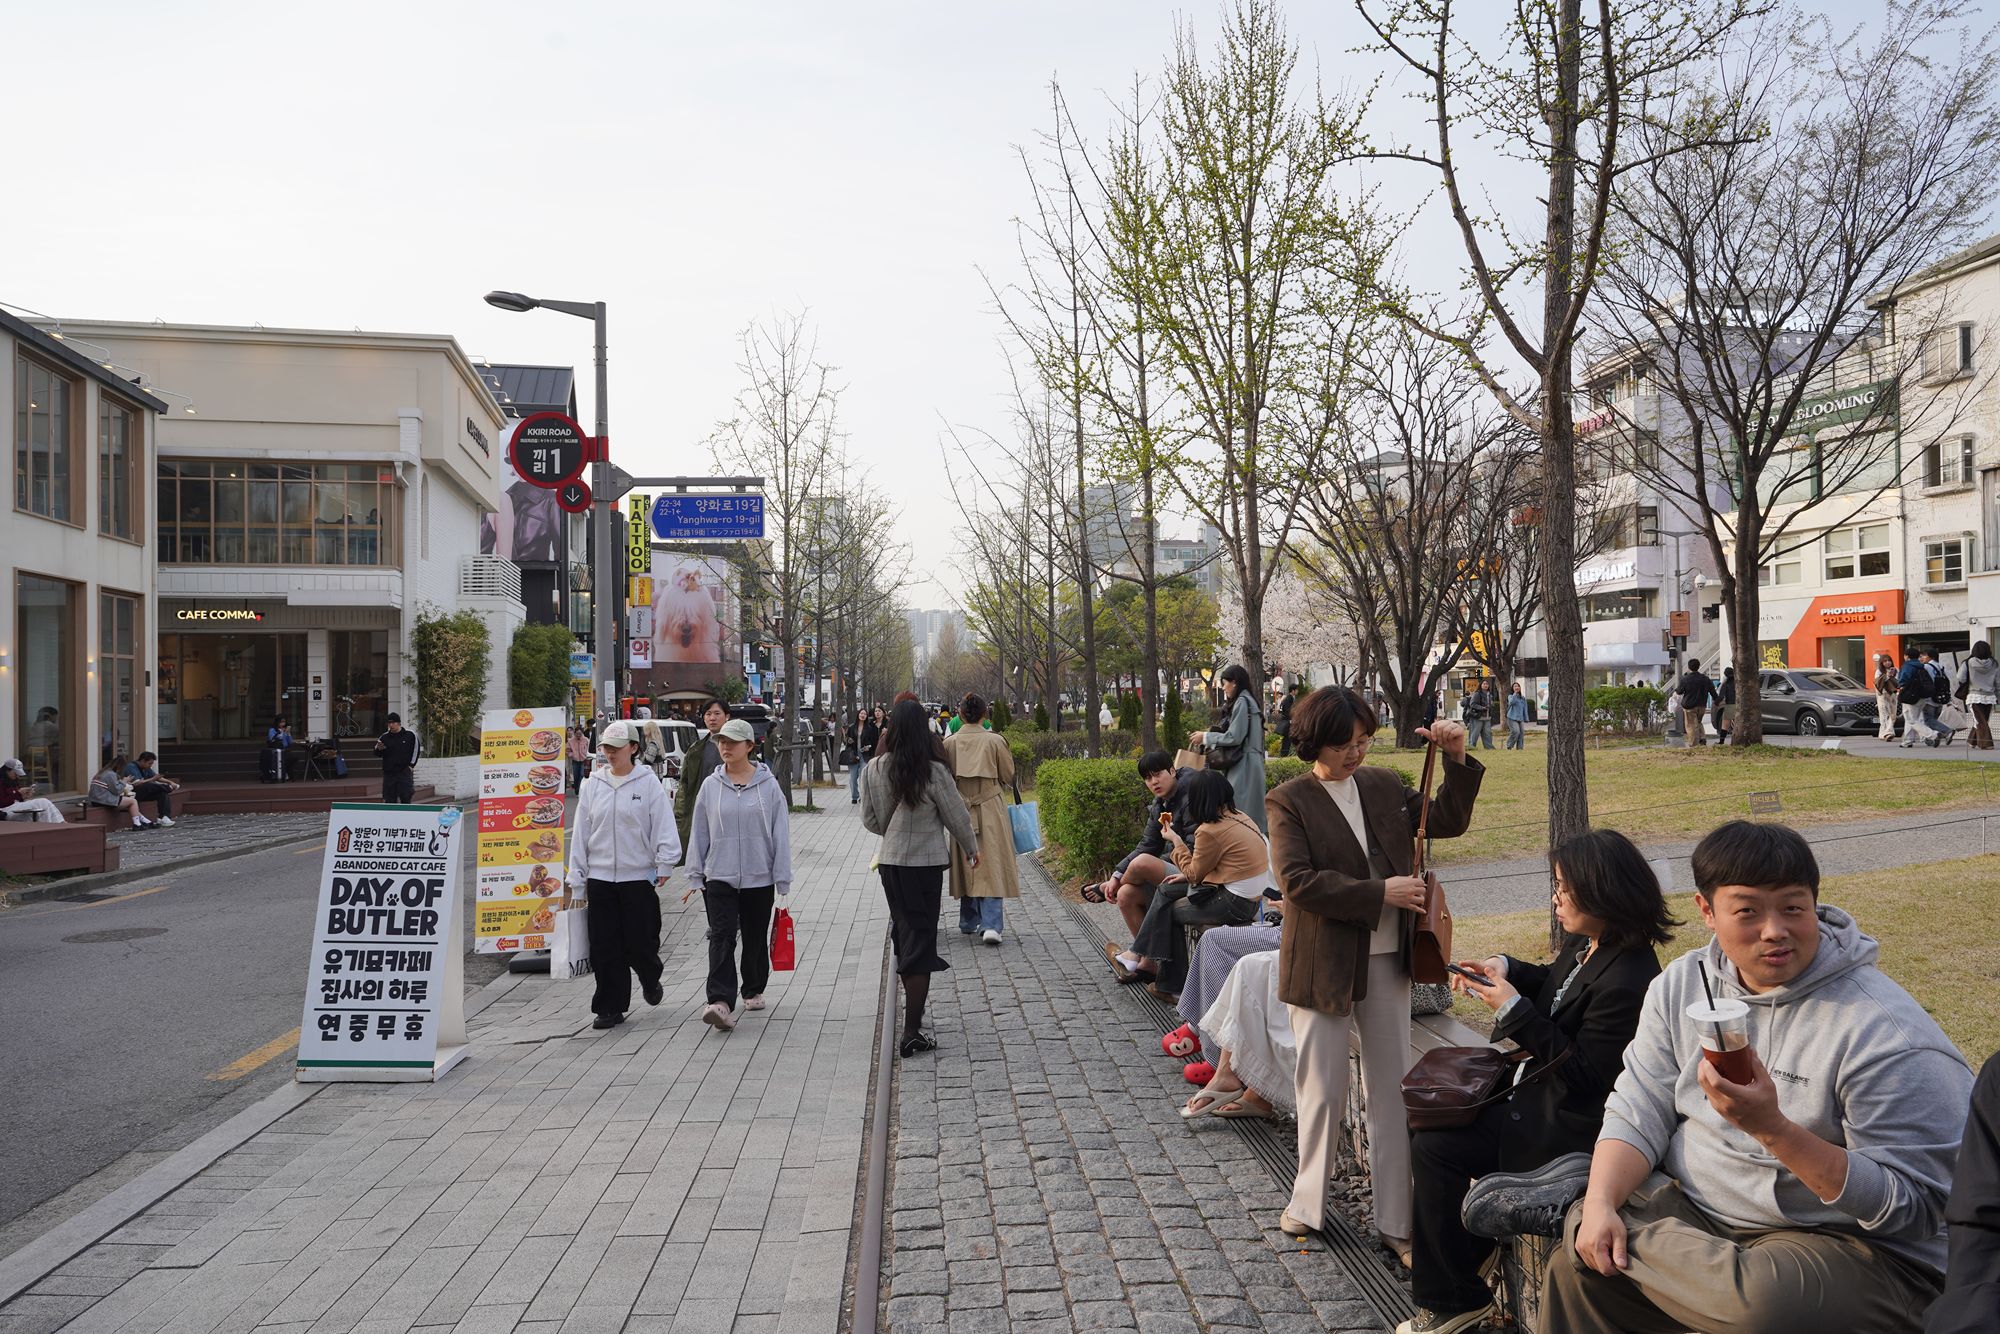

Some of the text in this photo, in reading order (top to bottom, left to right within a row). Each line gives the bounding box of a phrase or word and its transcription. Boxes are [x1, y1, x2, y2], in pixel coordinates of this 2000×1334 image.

[527, 428, 572, 436] KKIRI ROAD
[550, 448, 560, 475] 1
[695, 499, 760, 513] 양화로19길
[677, 515, 760, 526] Yanghwa-ro 19-gil
[631, 499, 643, 569] TATTOO
[177, 610, 207, 620] CAFE
[1820, 604, 1876, 616] PHOTOISM
[1822, 613, 1875, 625] COLORED
[632, 640, 650, 661] 약
[354, 827, 426, 840] 방문이 기부가 되는
[353, 840, 425, 853] 착한 유기묘카페
[514, 850, 529, 860] 9.4
[334, 861, 446, 872] ABANDONED CAT CAFE
[330, 877, 445, 908] DAY OF
[328, 908, 439, 936] BUTLER
[323, 949, 433, 974] 유기묘카페
[320, 979, 428, 1004] 집사의 하루
